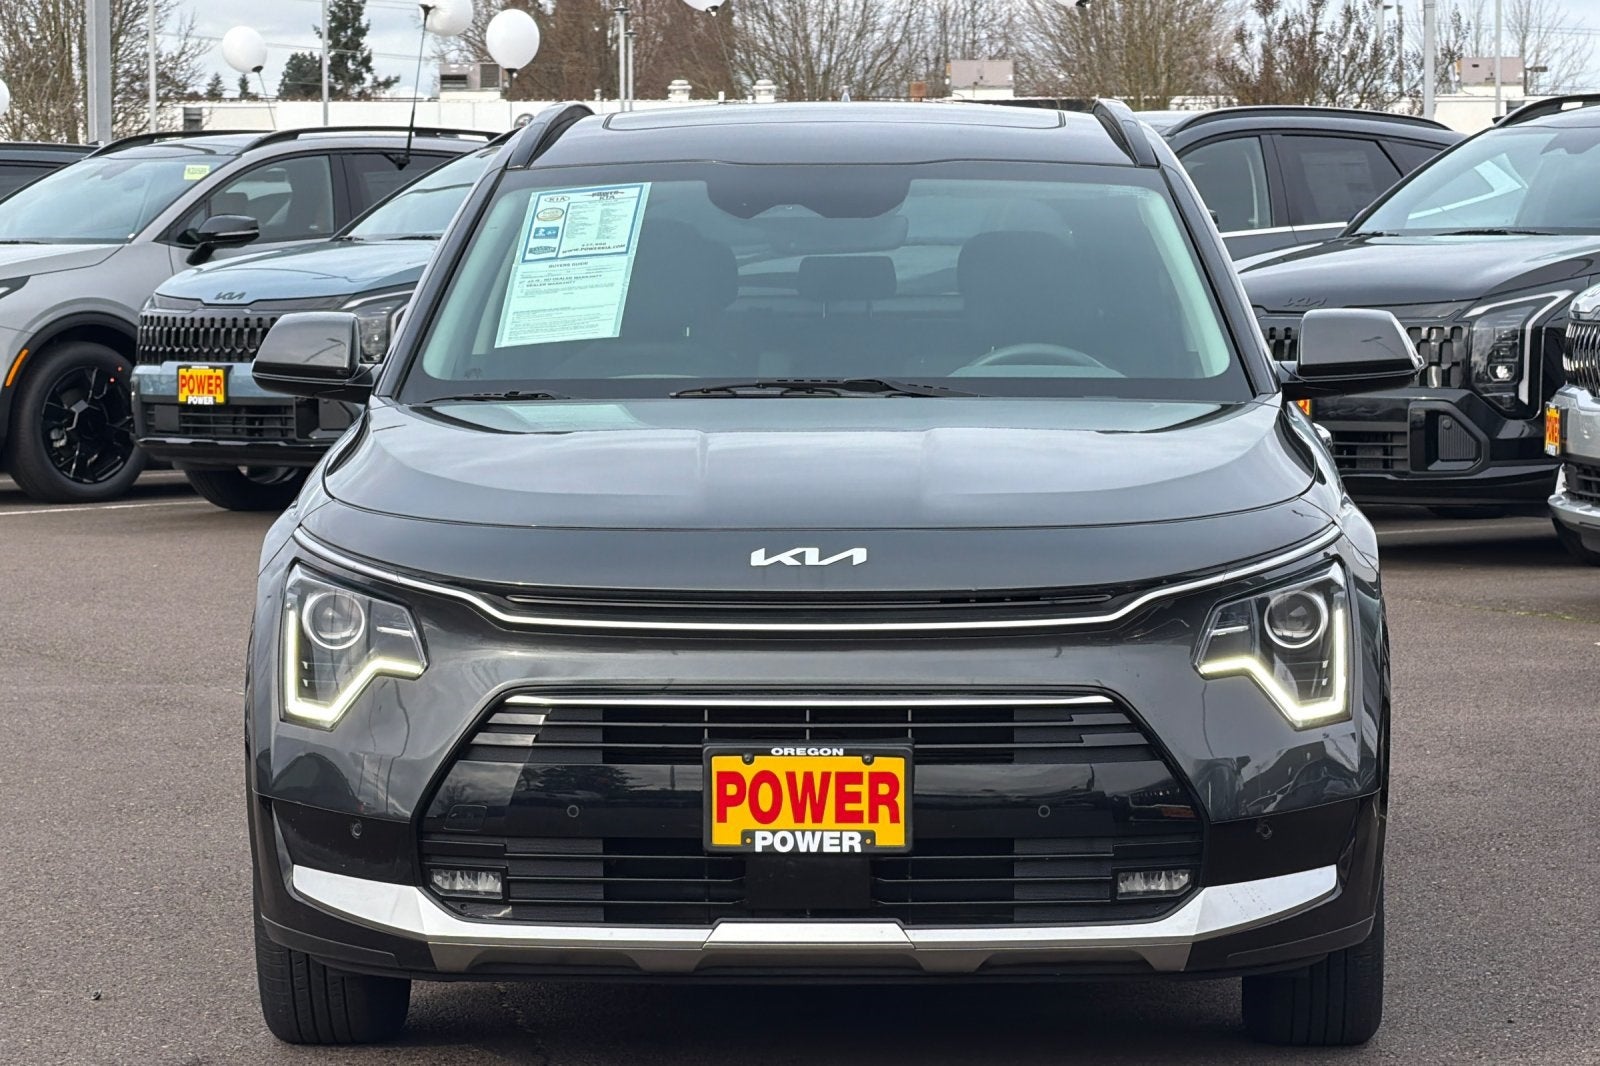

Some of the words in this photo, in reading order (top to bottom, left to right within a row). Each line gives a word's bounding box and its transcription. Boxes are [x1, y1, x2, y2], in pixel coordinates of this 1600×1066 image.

[180, 374, 223, 395] POWER
[187, 396, 214, 405] POWER
[750, 547, 867, 566] KIA
[770, 747, 844, 756] OREGON
[716, 769, 901, 825] POWER
[754, 830, 862, 853] POWER
